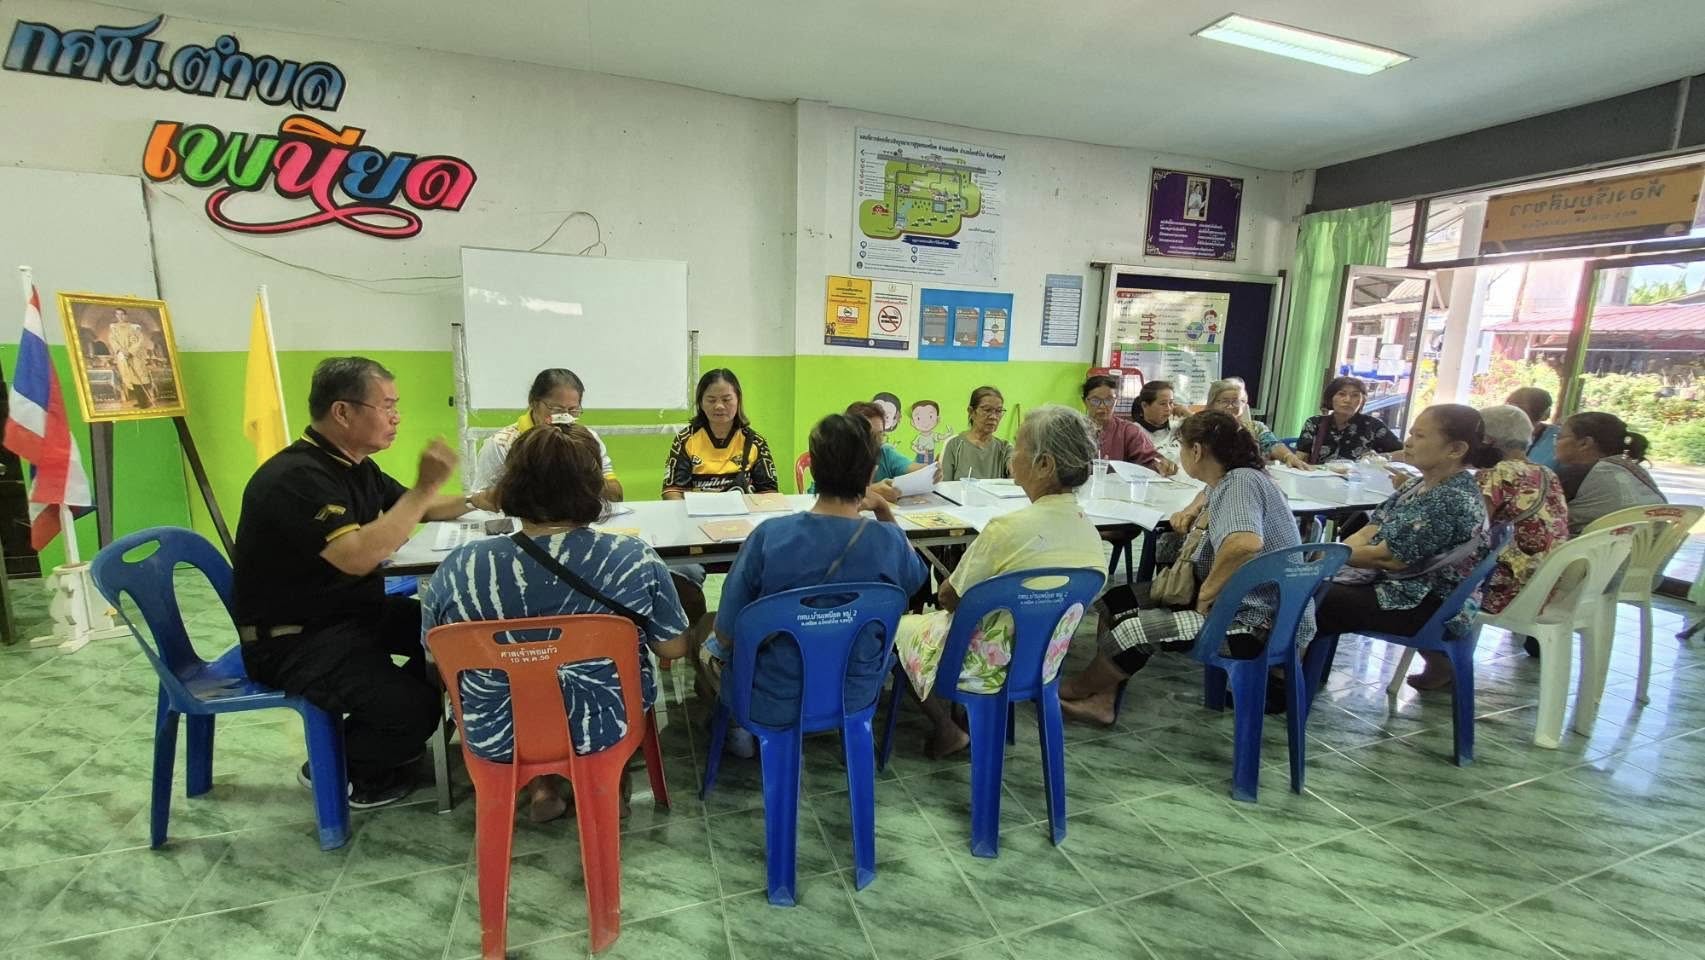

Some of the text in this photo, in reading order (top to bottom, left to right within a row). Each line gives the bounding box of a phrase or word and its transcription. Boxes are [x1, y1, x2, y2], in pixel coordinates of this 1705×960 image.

[3, 14, 346, 112] กศน.ตำบล
[141, 114, 477, 239] เพนียด
